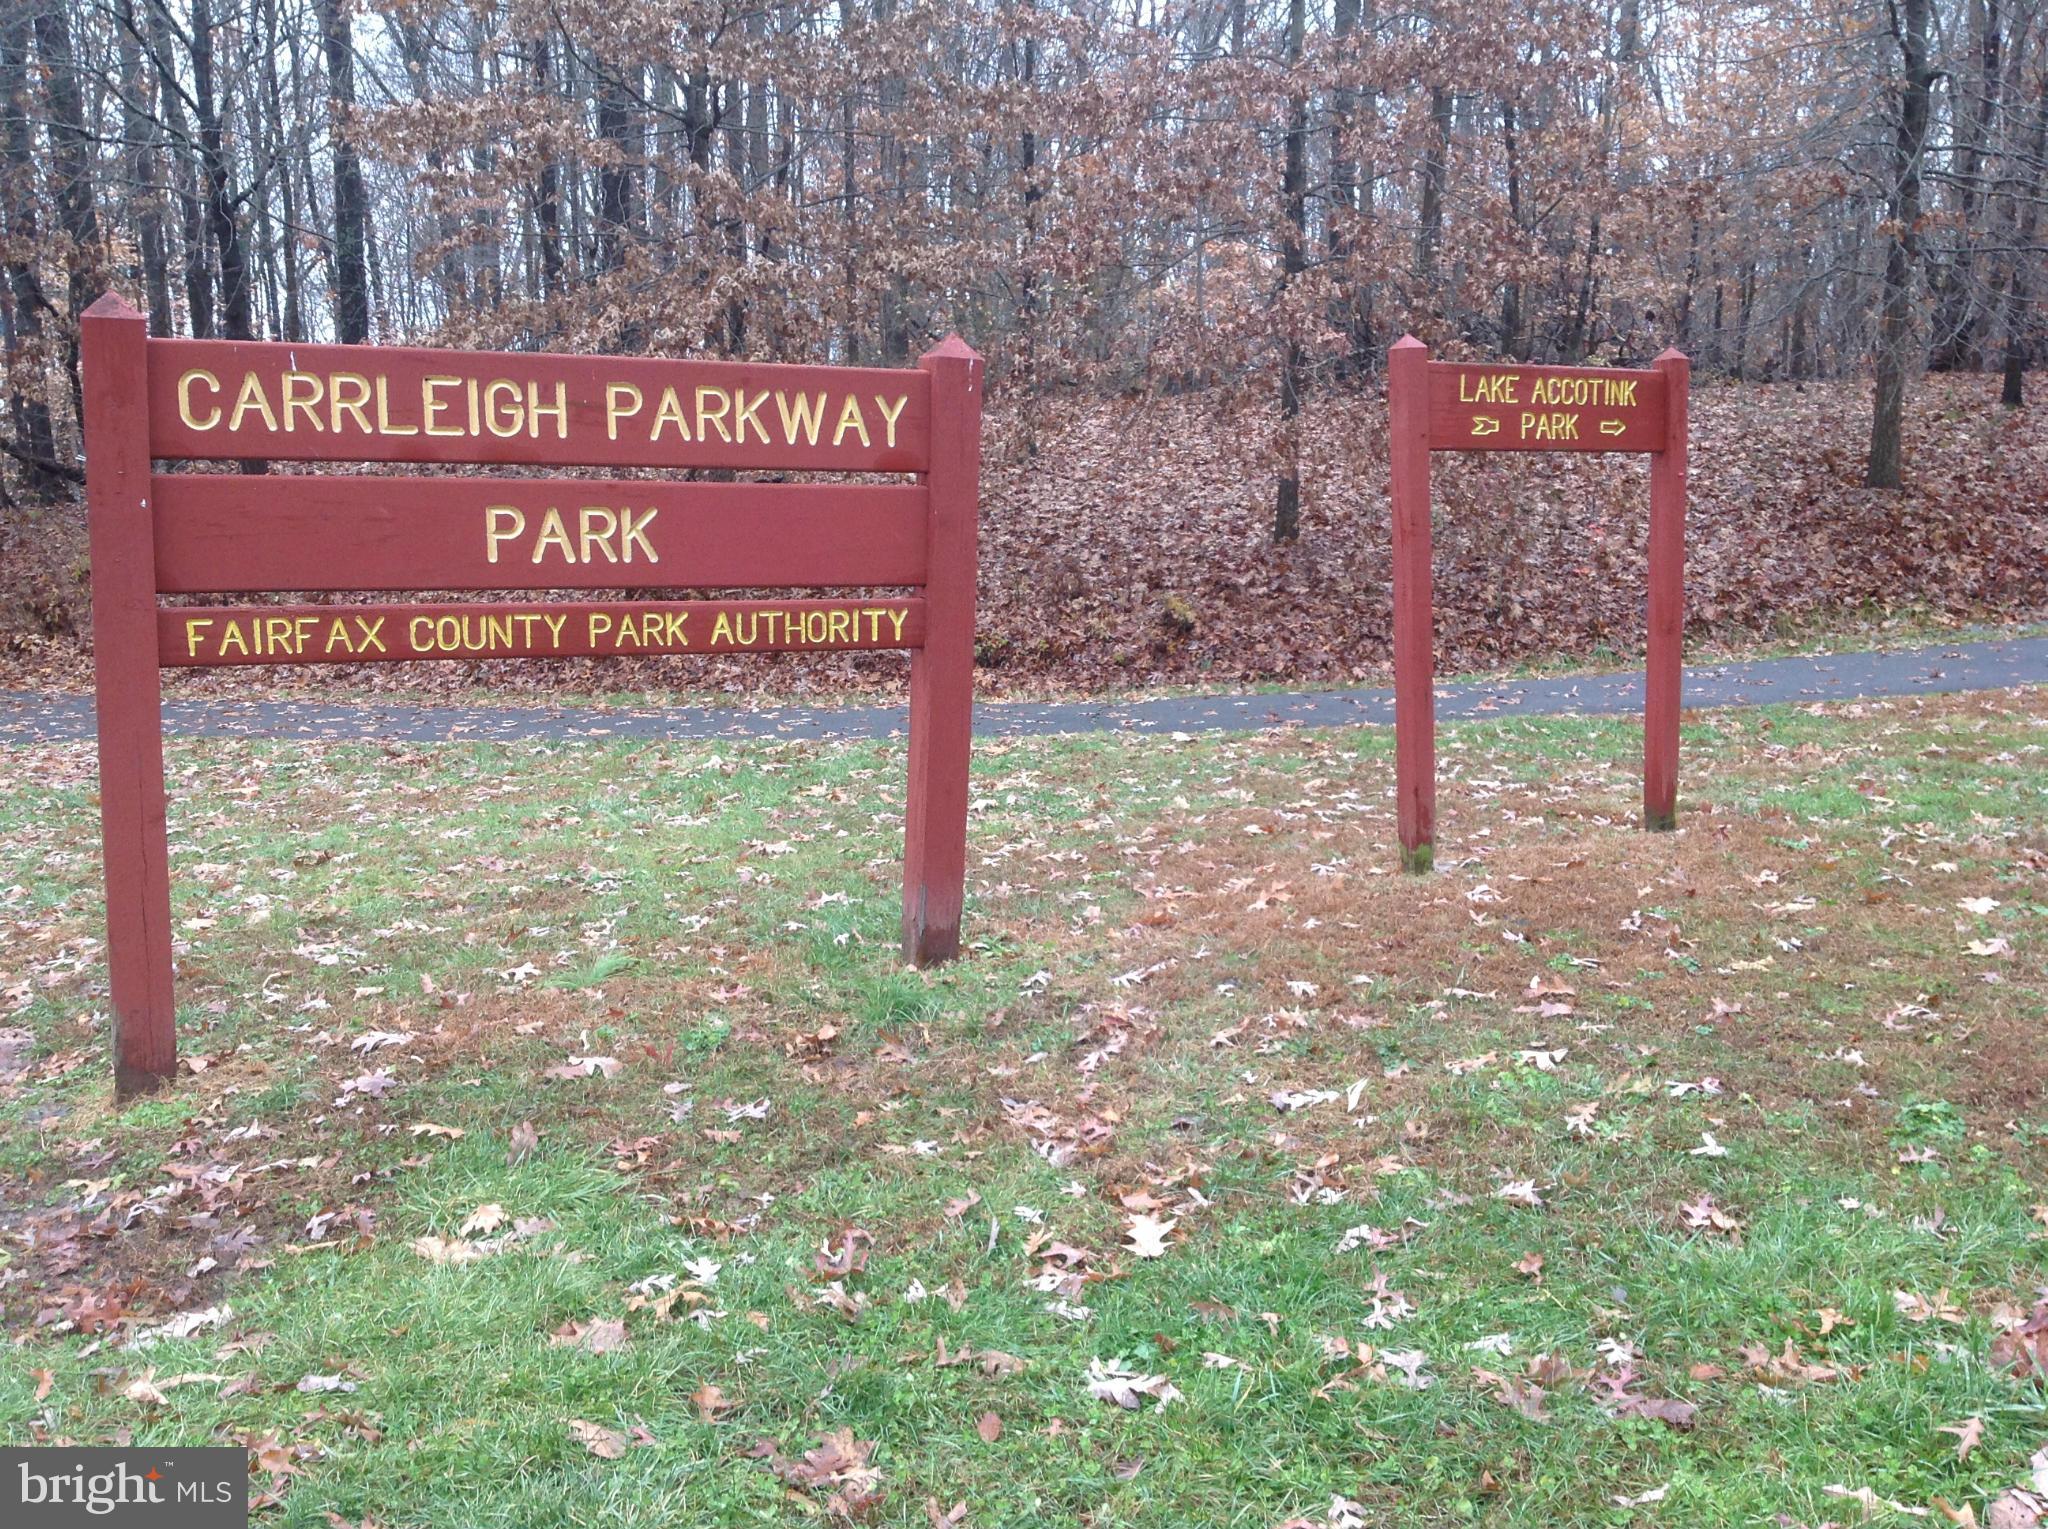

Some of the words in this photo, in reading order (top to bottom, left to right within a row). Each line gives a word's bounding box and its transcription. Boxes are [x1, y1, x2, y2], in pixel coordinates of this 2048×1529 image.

[176, 369, 569, 441] CARRLEIGH
[604, 383, 910, 450] PARKWAY
[1458, 373, 1520, 404] LAKE
[1530, 376, 1639, 407] ACCOTINK
[1520, 412, 1580, 440] PARK
[484, 505, 660, 565] PARK
[185, 615, 387, 658] FAIRFAX
[408, 612, 568, 653] COUNTY
[587, 611, 690, 649] PARK
[709, 607, 910, 647] AUTHORITY
